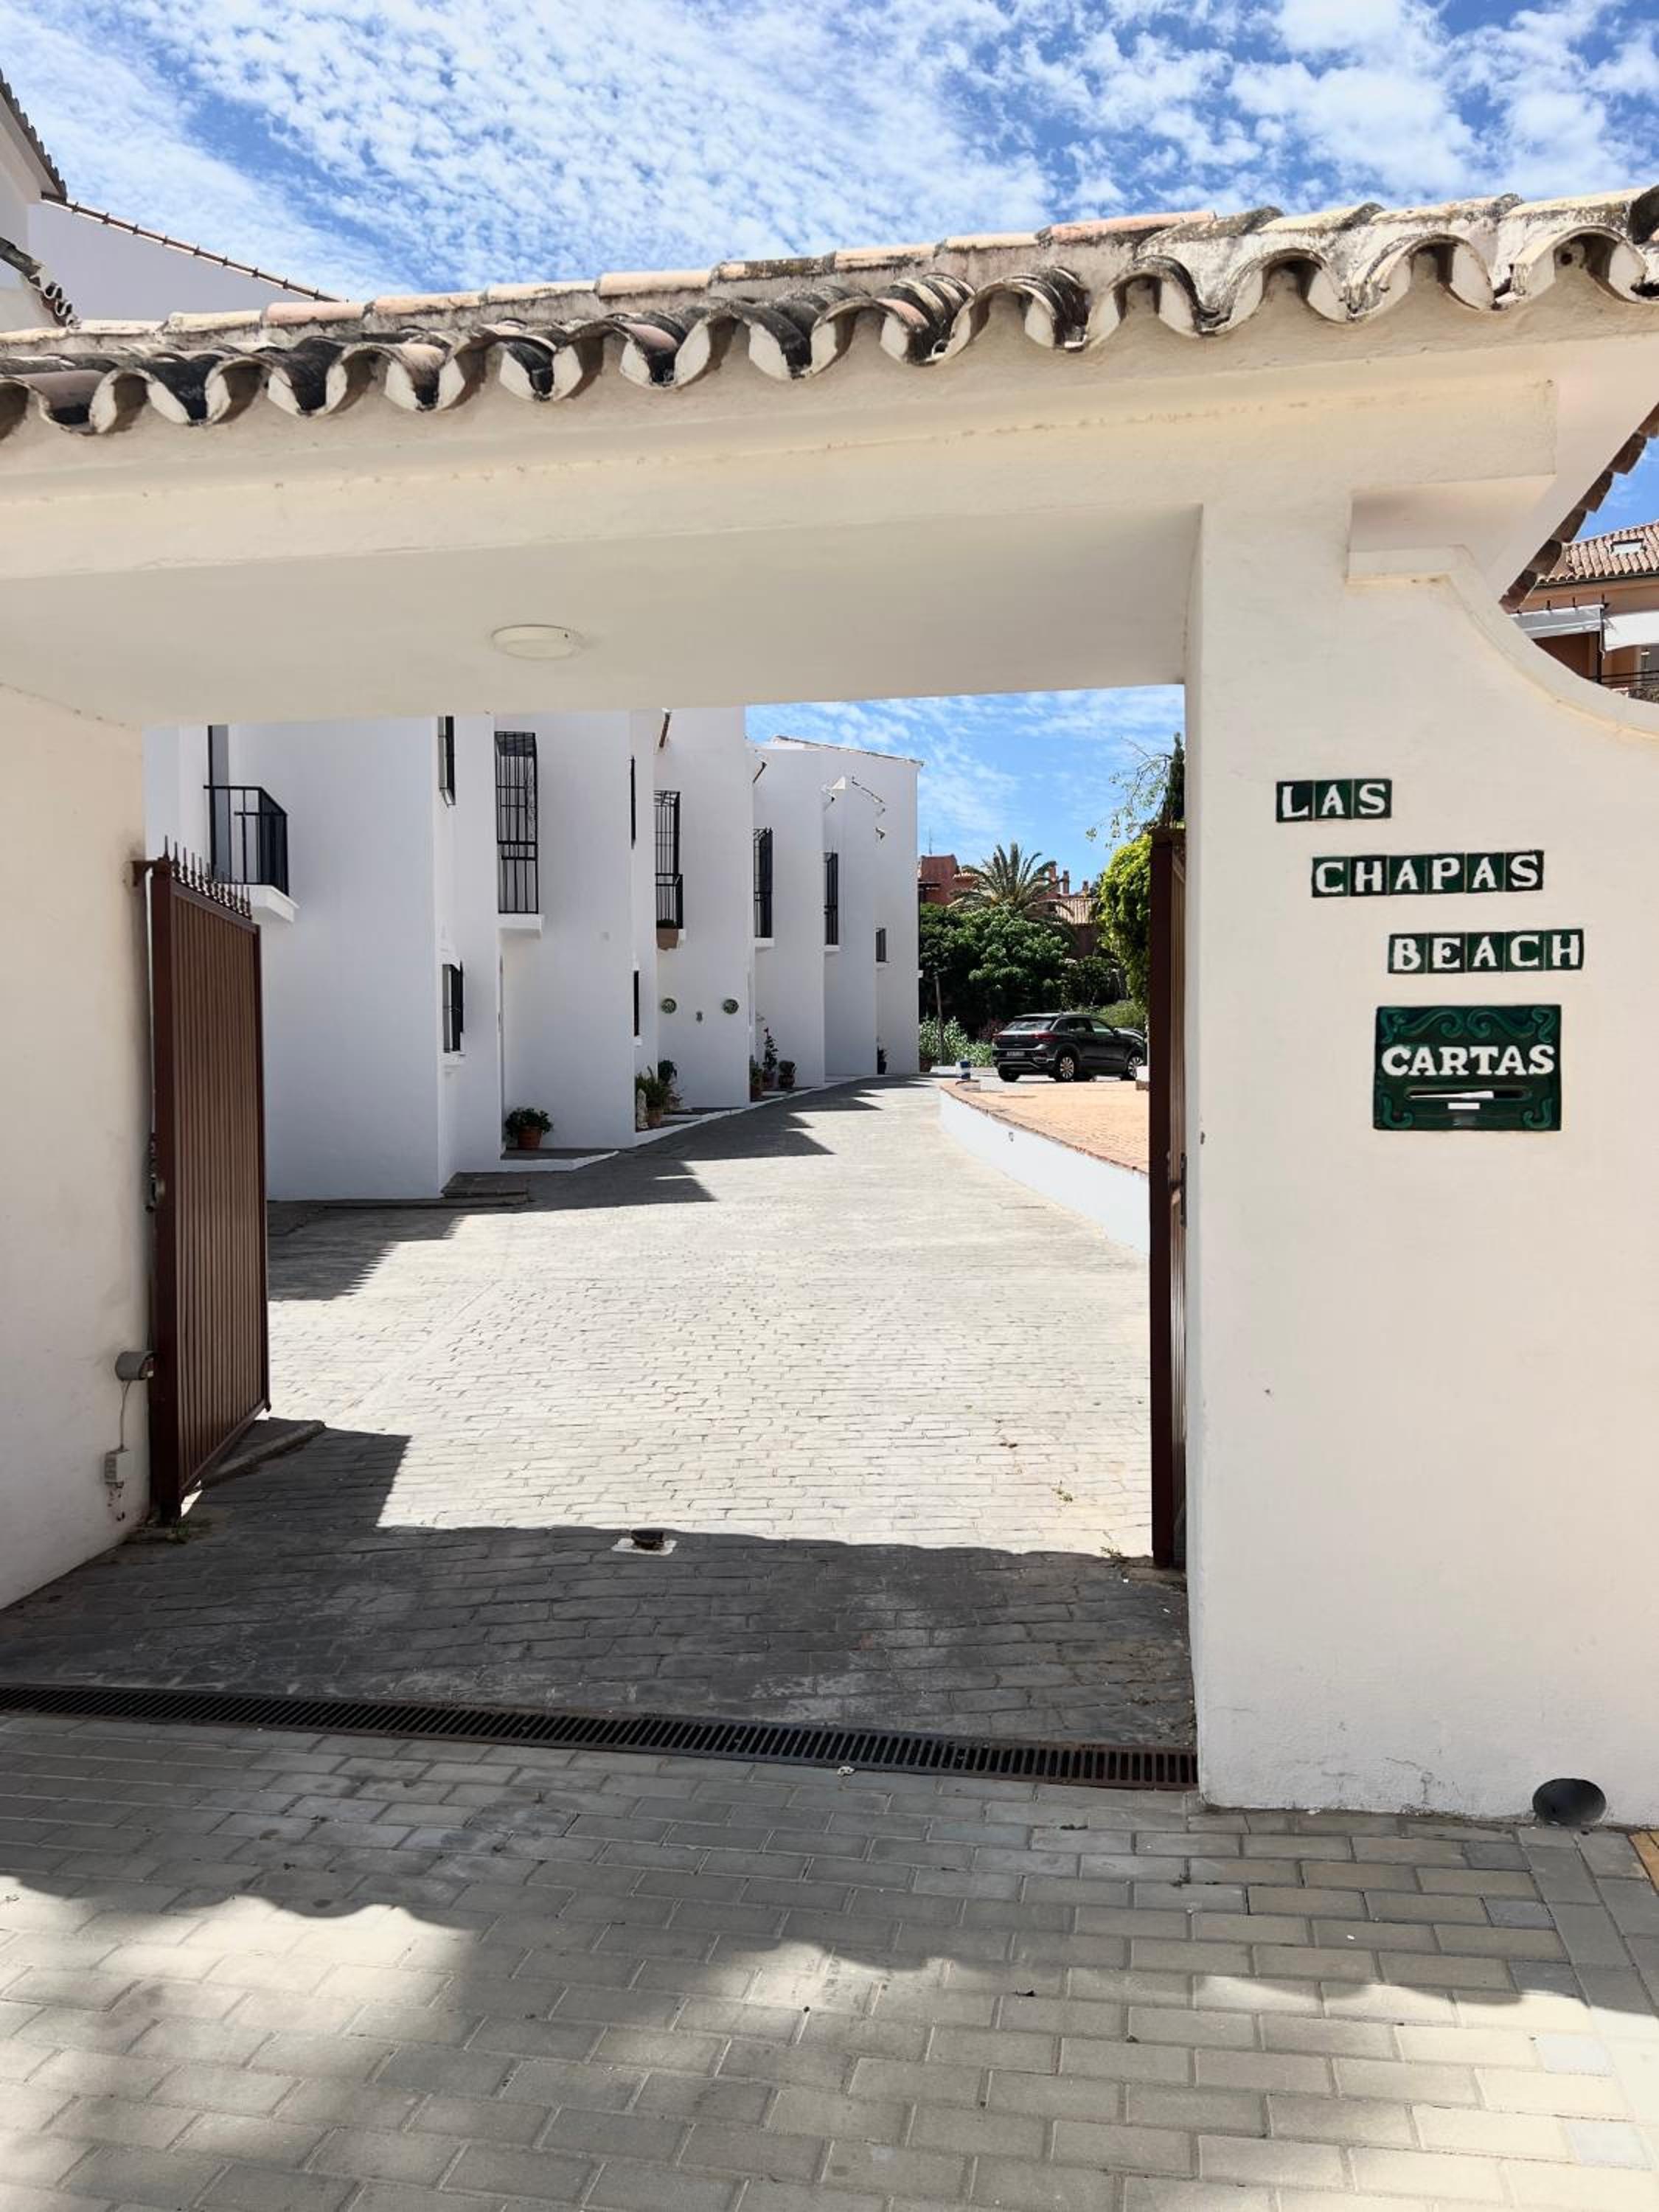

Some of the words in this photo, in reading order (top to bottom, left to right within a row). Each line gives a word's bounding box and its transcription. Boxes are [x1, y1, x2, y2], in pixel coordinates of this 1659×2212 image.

[1281, 783, 1386, 818] LAS
[1315, 855, 1539, 893] CHAPAS
[1393, 934, 1579, 971] BEACH
[1381, 1045, 1555, 1076] CARTAS
